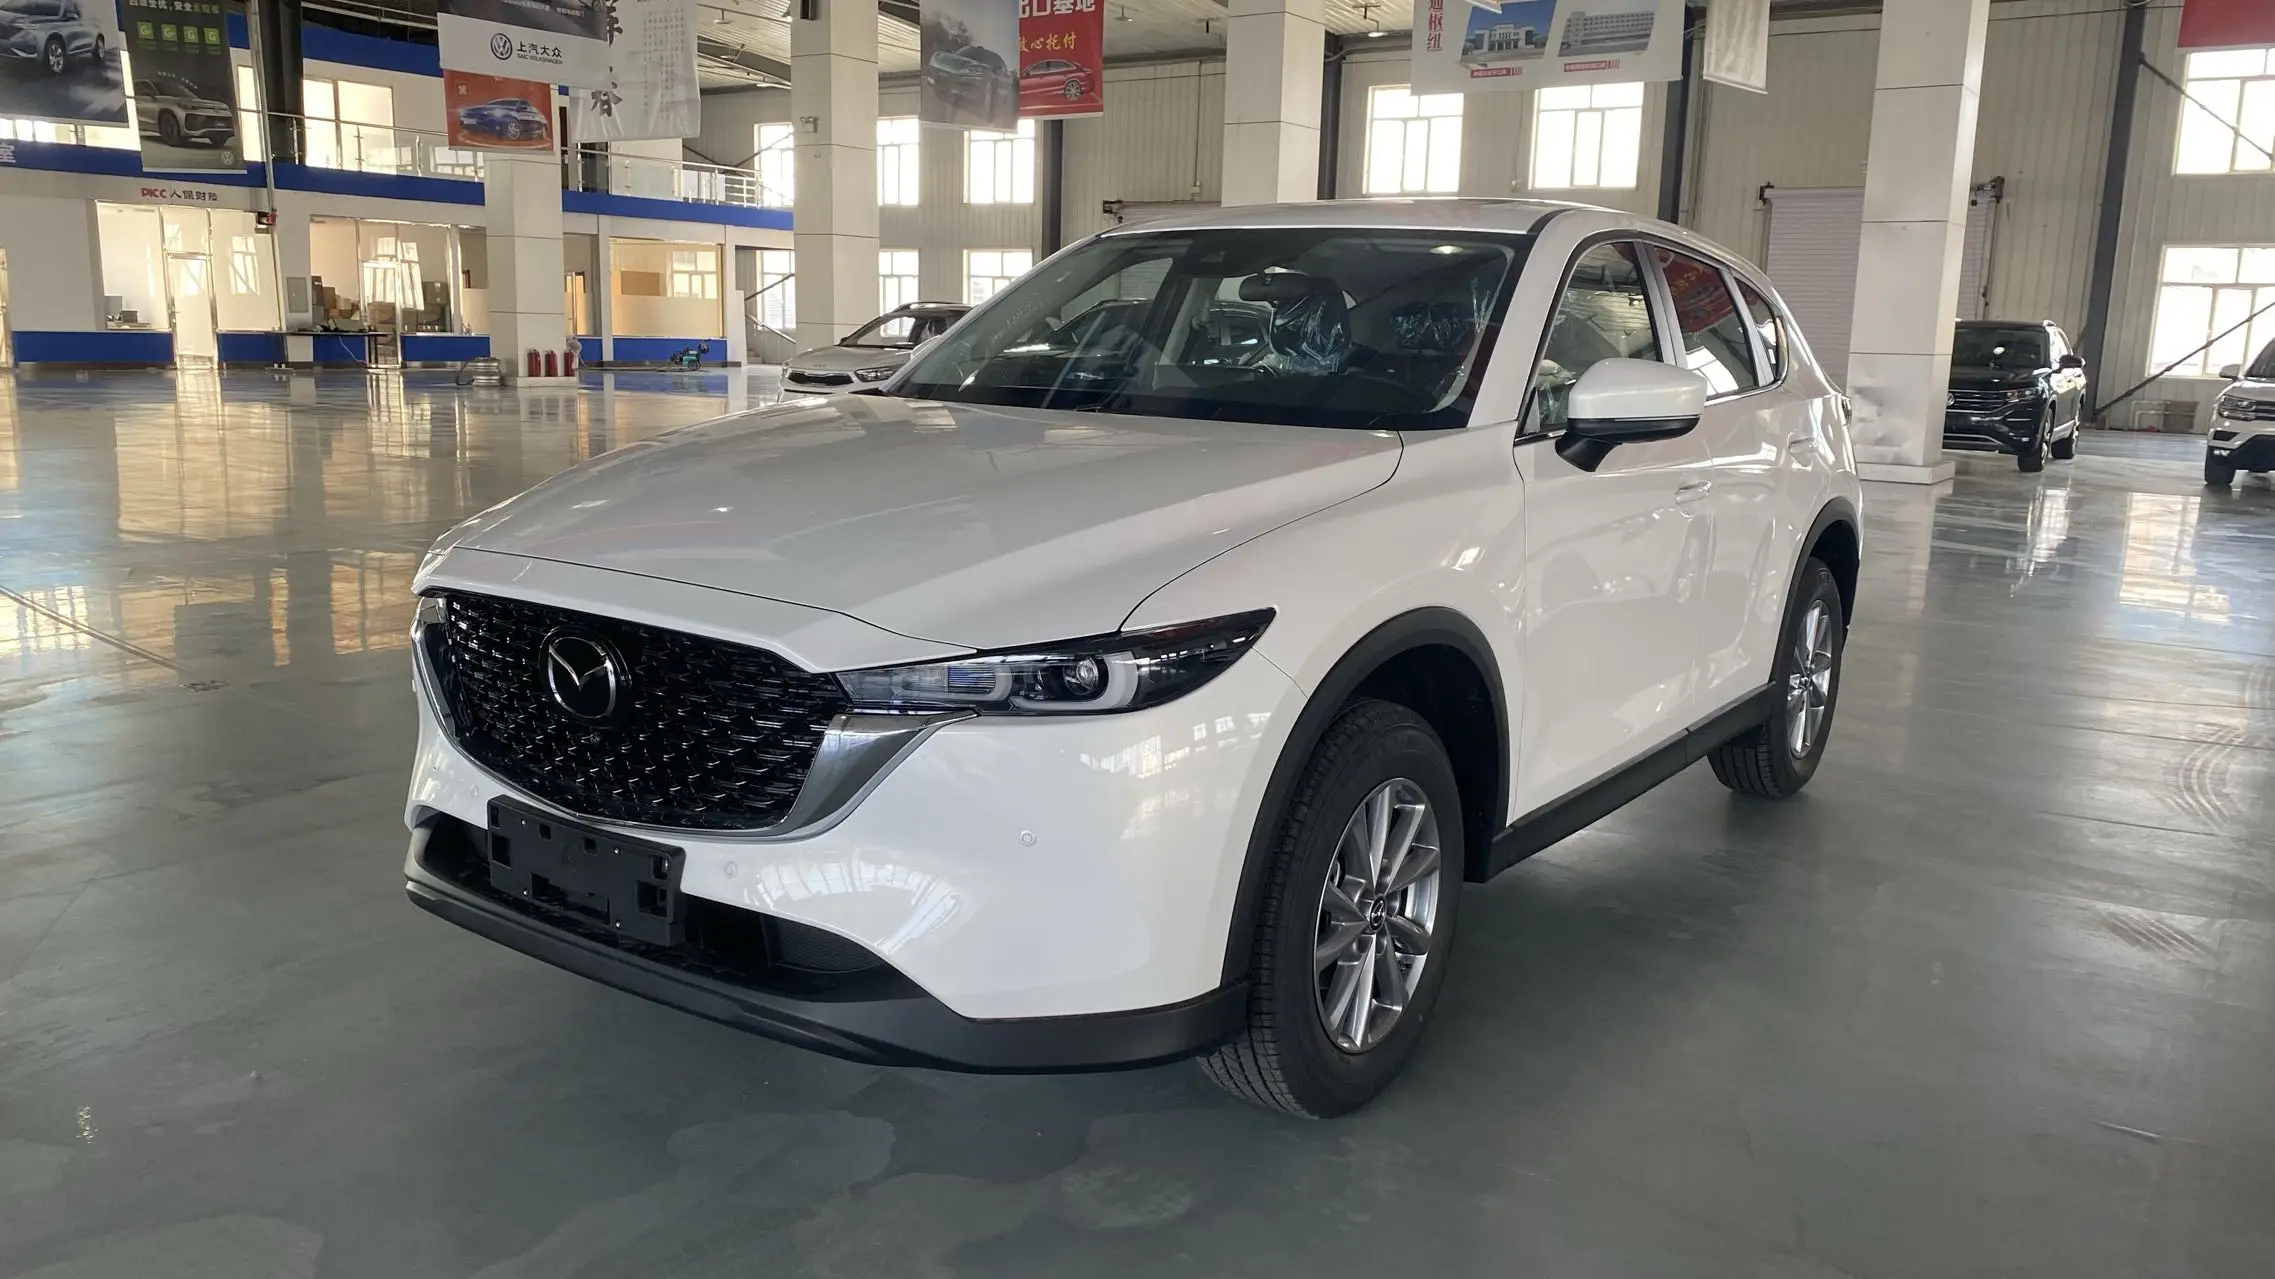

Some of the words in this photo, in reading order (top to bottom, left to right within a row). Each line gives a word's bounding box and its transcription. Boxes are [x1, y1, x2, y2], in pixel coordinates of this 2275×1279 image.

[517, 40, 562, 58] 上汽大众
[529, 55, 563, 65] VOLKSWAGEN
[141, 187, 167, 199] PICC
[170, 190, 218, 201] 人保财险
